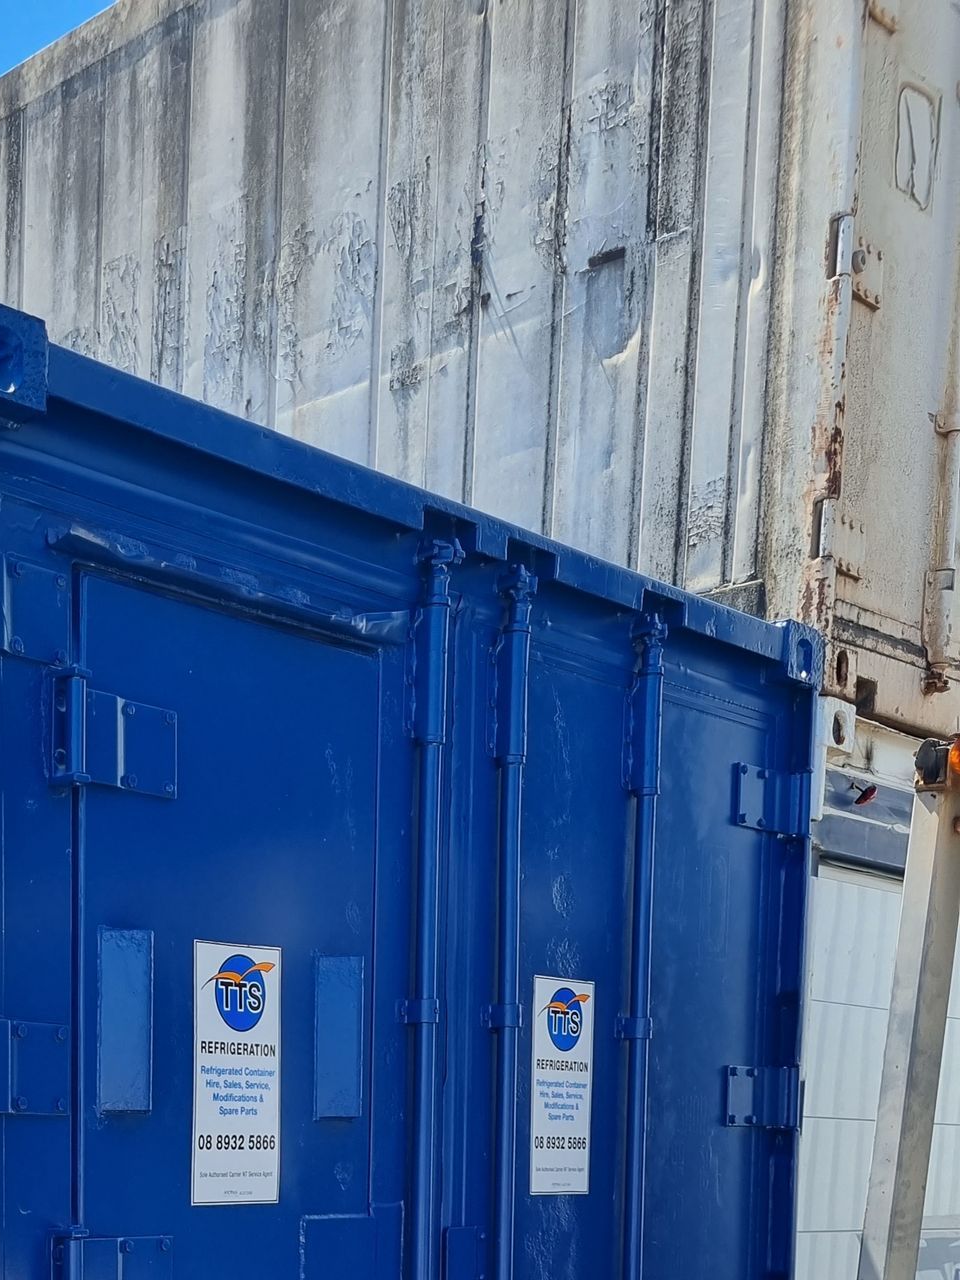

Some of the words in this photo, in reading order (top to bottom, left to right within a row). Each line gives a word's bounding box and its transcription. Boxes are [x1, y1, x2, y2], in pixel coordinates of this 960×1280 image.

[218, 980, 262, 1013] TTS
[550, 1008, 581, 1037] TTS
[200, 1040, 276, 1057] REFRIGERATION
[200, 1065, 243, 1077] Refrigerated
[244, 1067, 276, 1077] Container
[536, 1058, 589, 1072] REFRIGERATION
[205, 1079, 222, 1089] Hire,
[223, 1080, 244, 1090] Sales,
[245, 1080, 271, 1091] Service,
[212, 1092, 258, 1102] Modifications
[258, 1094, 264, 1102] &
[219, 1105, 239, 1117] Spare
[240, 1106, 258, 1115] Parts
[198, 1134, 212, 1150] 08
[216, 1134, 245, 1150] 8932
[248, 1134, 276, 1150] 5866
[534, 1136, 544, 1149] 08
[546, 1136, 566, 1149] 8932
[567, 1136, 587, 1150] 5866
